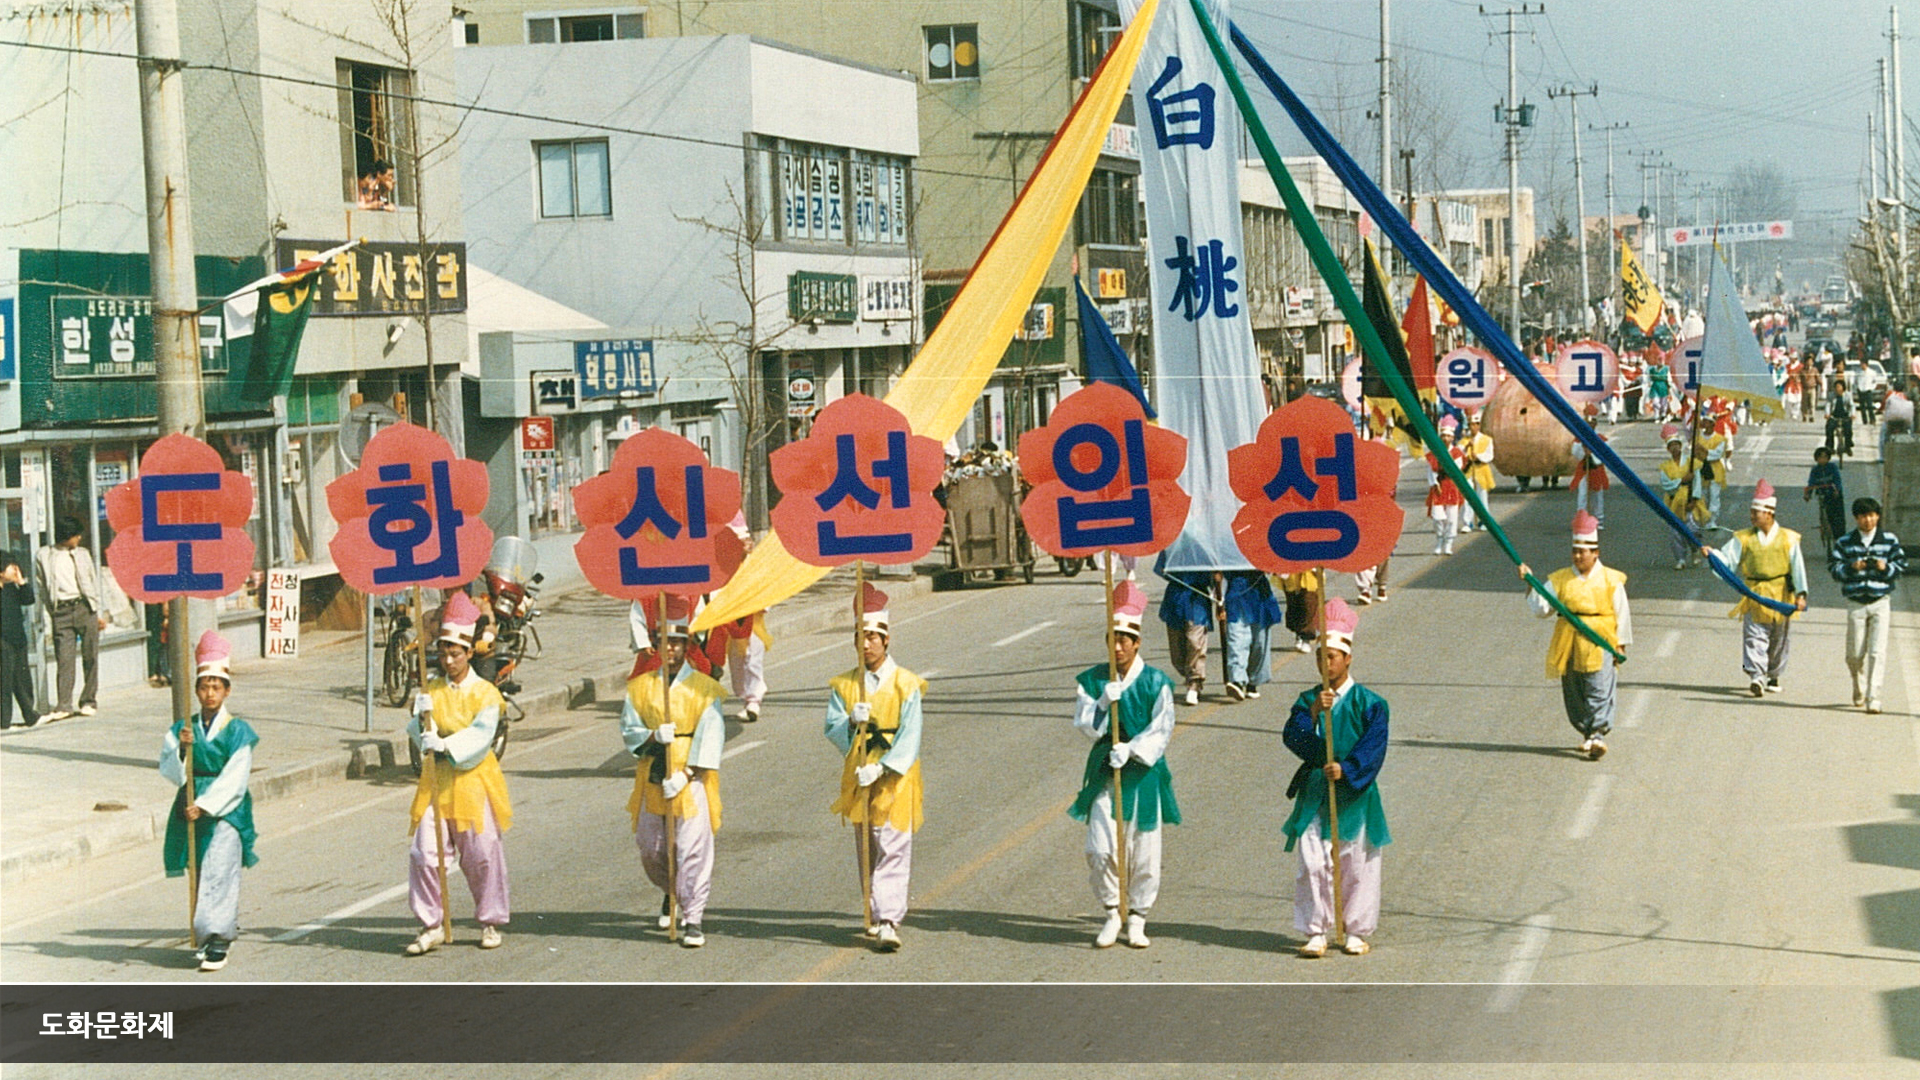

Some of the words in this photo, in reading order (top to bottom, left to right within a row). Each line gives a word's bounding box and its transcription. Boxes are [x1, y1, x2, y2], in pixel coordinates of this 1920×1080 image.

[1146, 56, 1239, 322] 白桃
[61, 315, 224, 364] 한성구
[1448, 358, 1485, 399] 원
[1570, 352, 1604, 392] 고
[140, 472, 224, 592] 도
[366, 460, 464, 585] 화
[614, 464, 710, 587] 신
[814, 430, 914, 557] 선
[1052, 418, 1154, 550] 입
[1262, 432, 1361, 561] 성
[269, 573, 283, 657] 전자복사
[283, 573, 299, 656] 청사진
